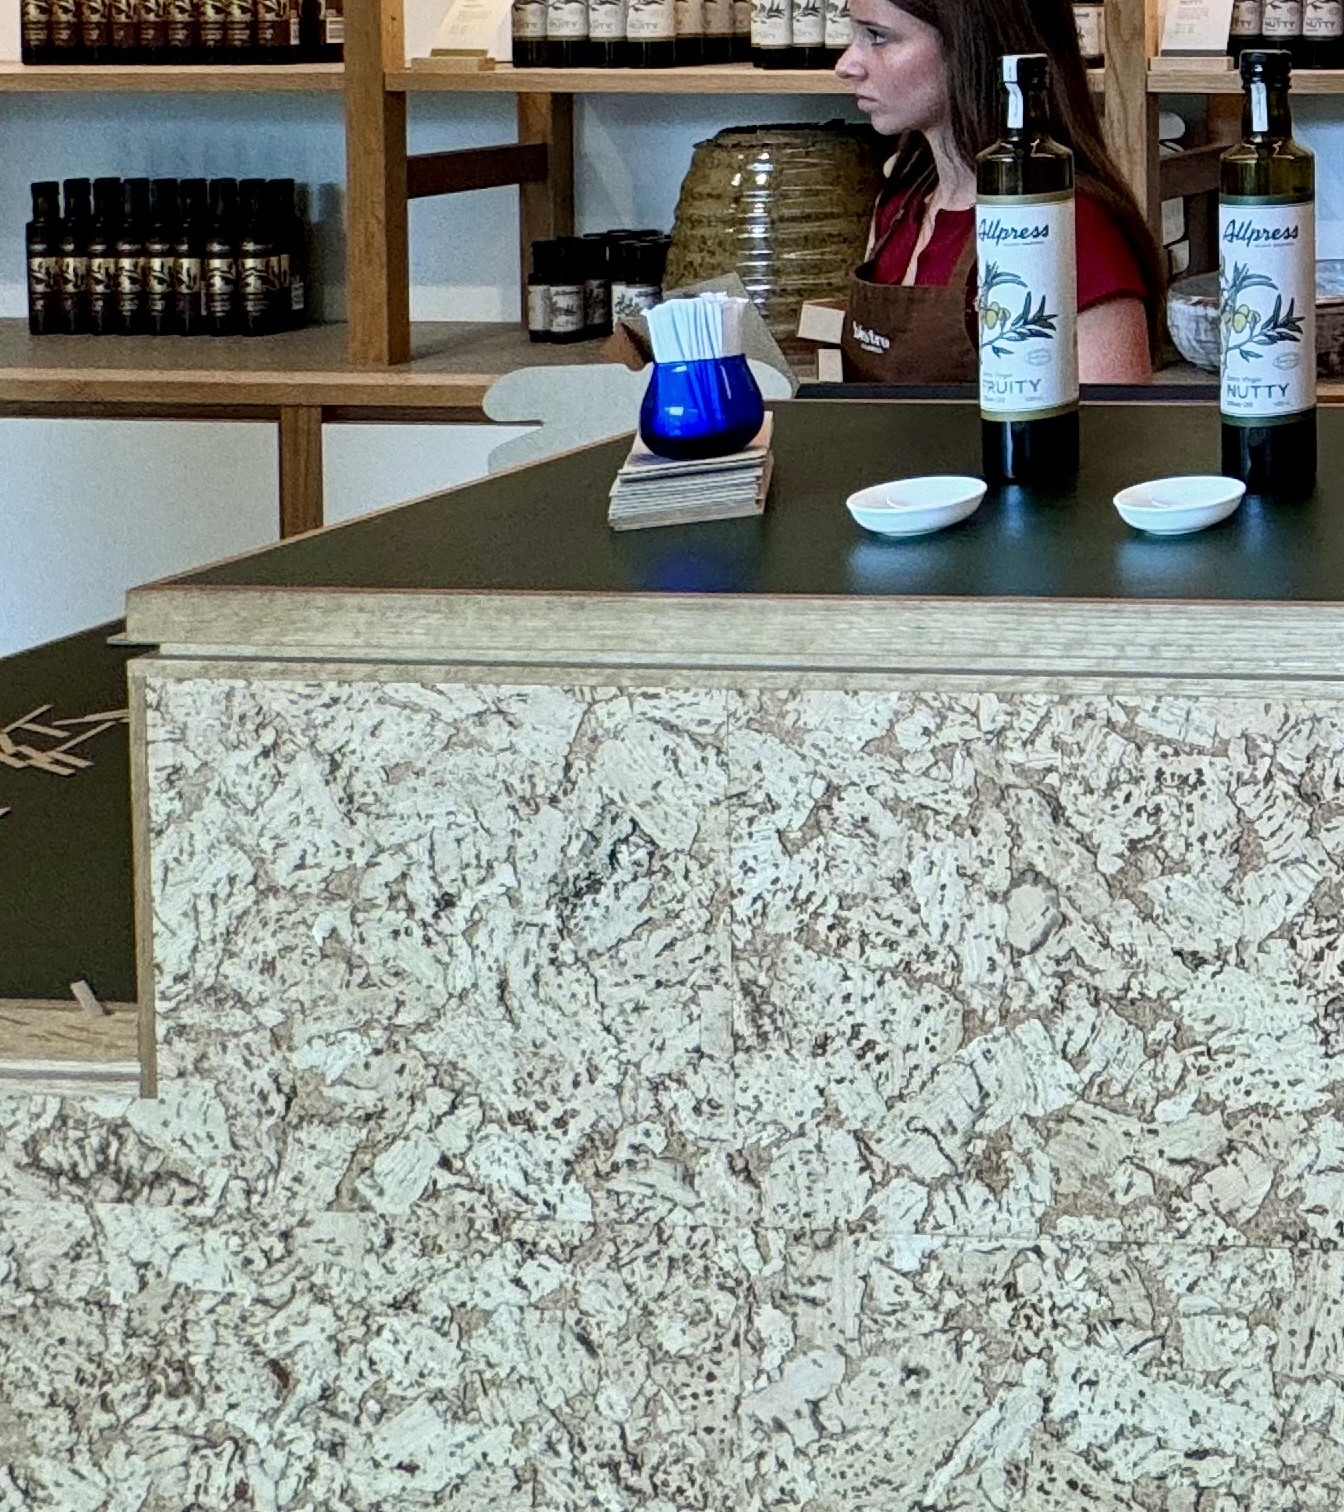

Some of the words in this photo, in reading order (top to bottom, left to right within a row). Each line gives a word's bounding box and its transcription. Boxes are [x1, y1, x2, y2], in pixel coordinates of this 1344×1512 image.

[978, 218, 1050, 246] Allpress
[1223, 219, 1299, 247] Allpress
[1227, 383, 1290, 399] NUTTY
